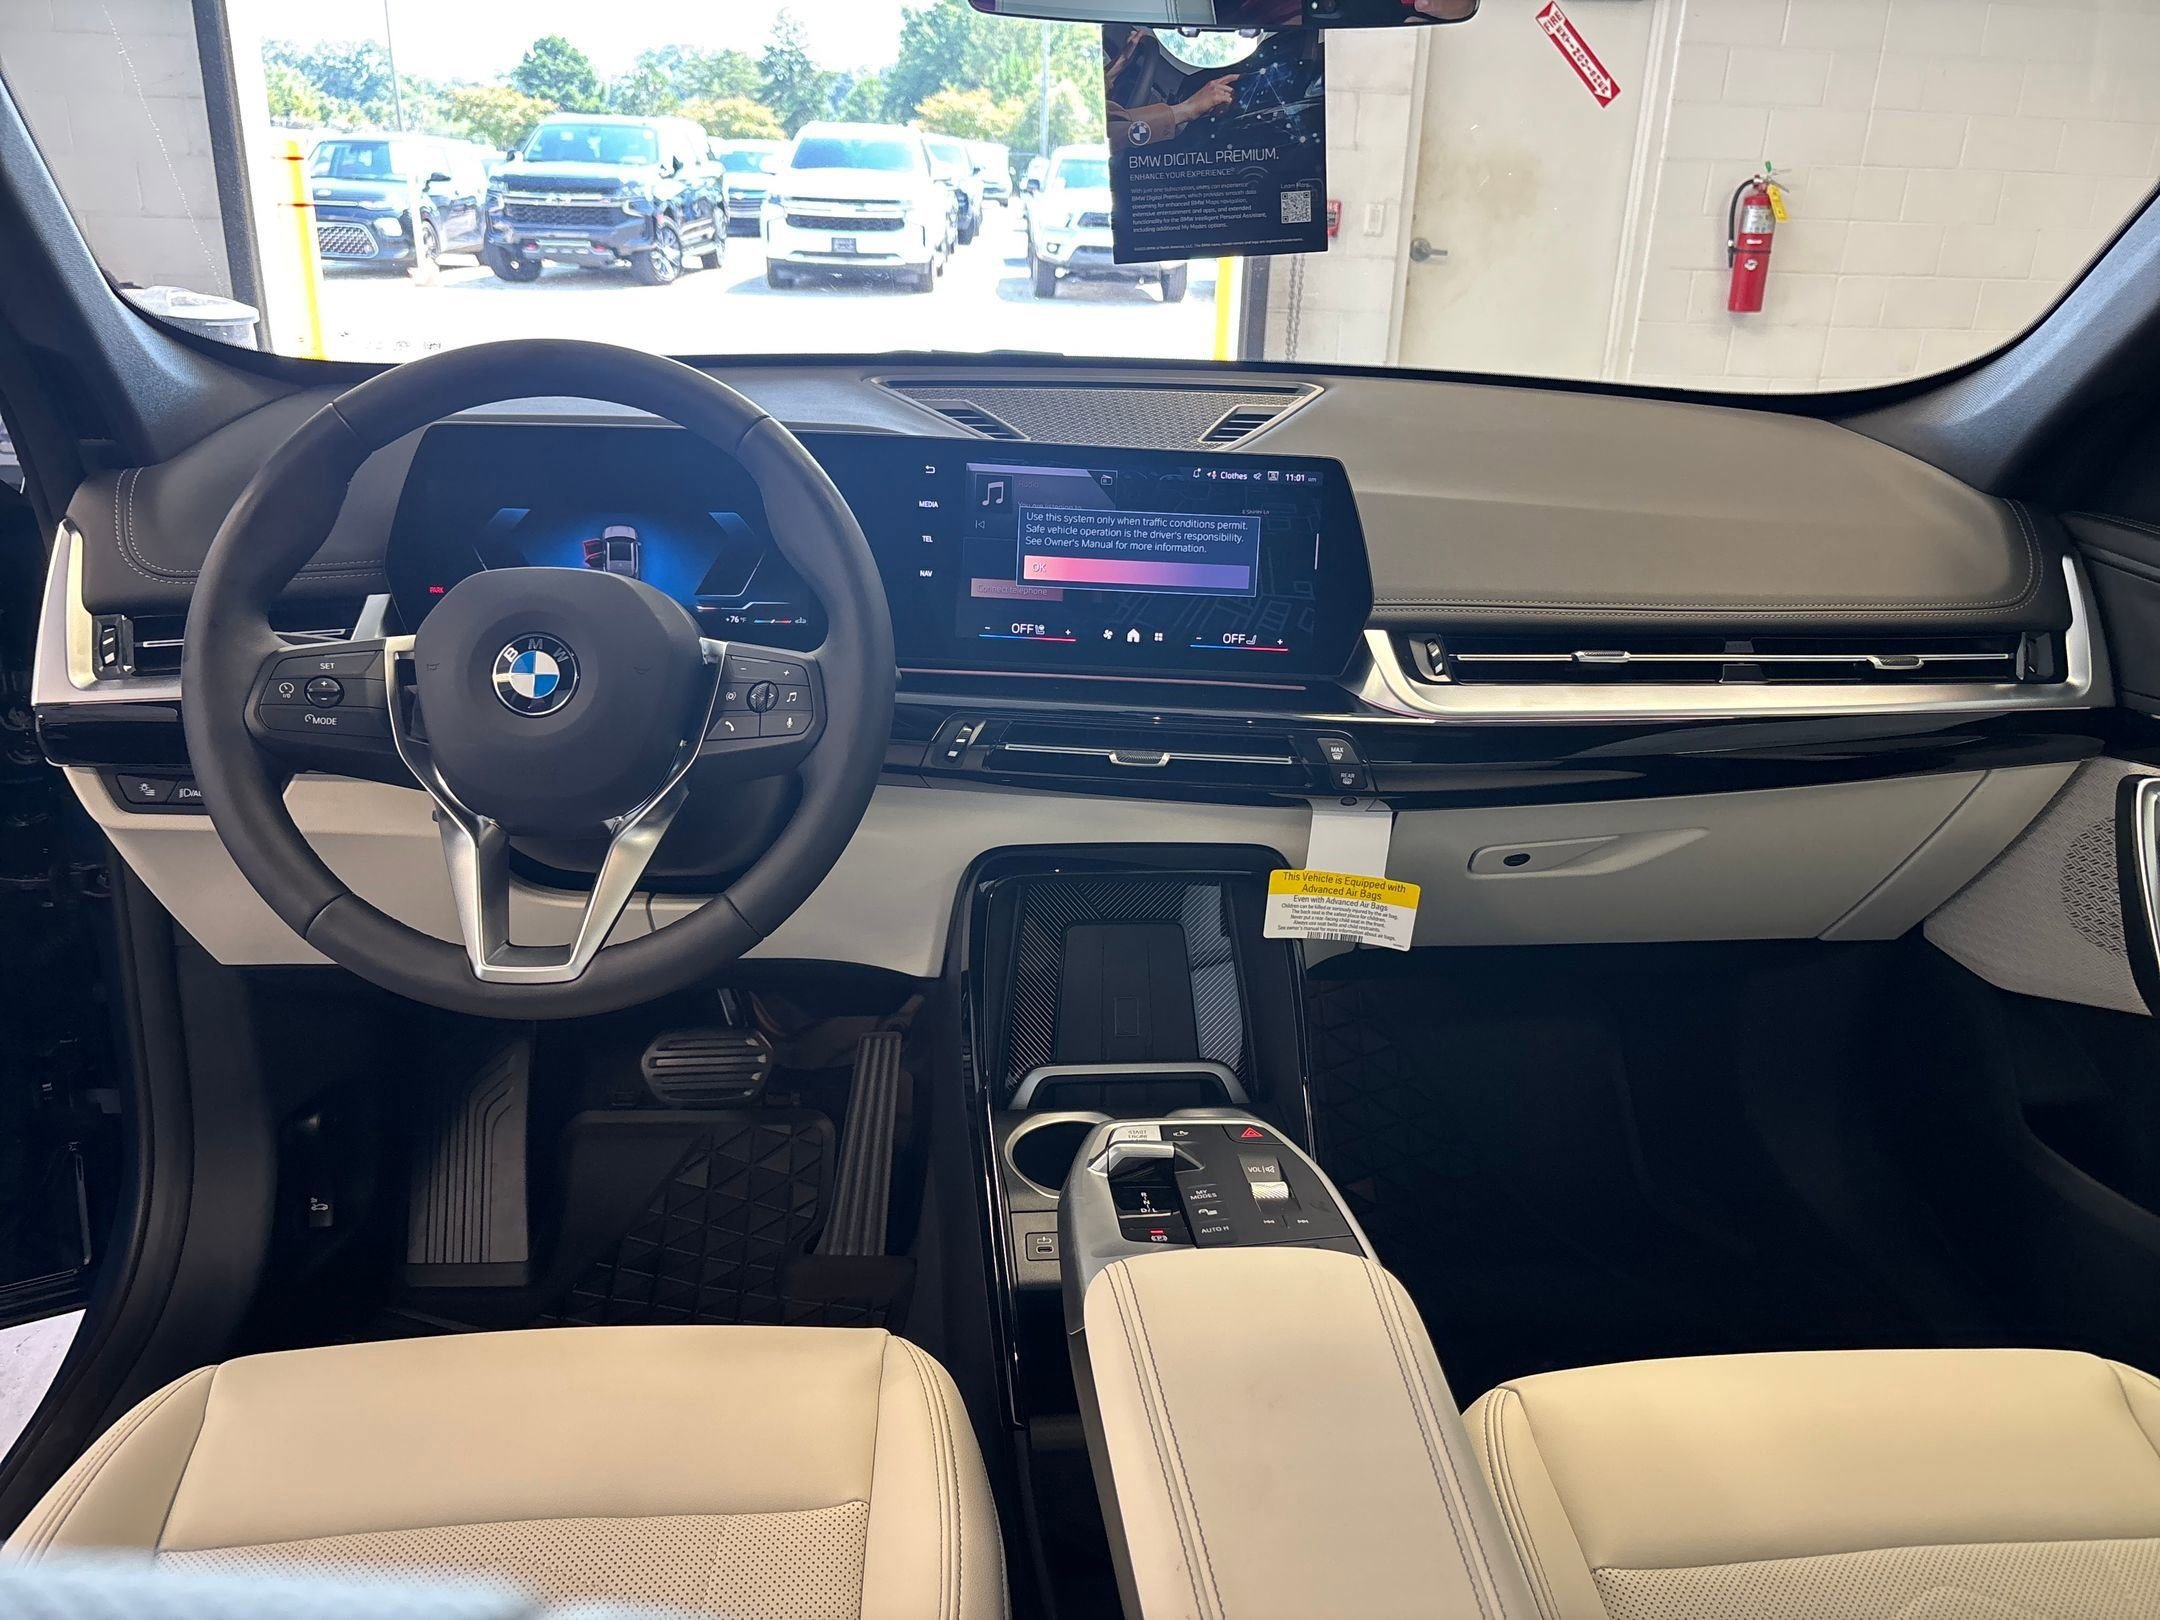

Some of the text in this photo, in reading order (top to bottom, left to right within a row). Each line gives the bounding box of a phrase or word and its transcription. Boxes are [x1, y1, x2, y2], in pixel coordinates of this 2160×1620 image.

[1543, 10, 1563, 33] FIRE
[1128, 147, 1280, 168] BMW DIGITAL PREMIUM.
[1130, 172, 1164, 182] ENHANCE
[1164, 170, 1186, 178] YOUR
[1220, 471, 1248, 480] Clothes
[1285, 473, 1305, 482] 11:01
[1026, 512, 1248, 531] Use this system only when traffic conditions permit.
[1026, 524, 1244, 544] Safe vehicle operation is the driver's responsibility.
[1025, 536, 1207, 553] See Owner's Manual for more information.
[1032, 563, 1047, 573] OK
[726, 616, 739, 624] +76
[1011, 623, 1034, 634] OFF
[1222, 633, 1246, 644] OFF
[503, 638, 570, 663] BMW
[312, 717, 337, 726] MODE
[1283, 872, 1406, 894] This Vehicle is Equipped with
[1302, 884, 1382, 902] Advanced Air Bags
[1294, 895, 1388, 912] Even with Advanced Air Bags
[1201, 1226, 1222, 1234] AUTO
